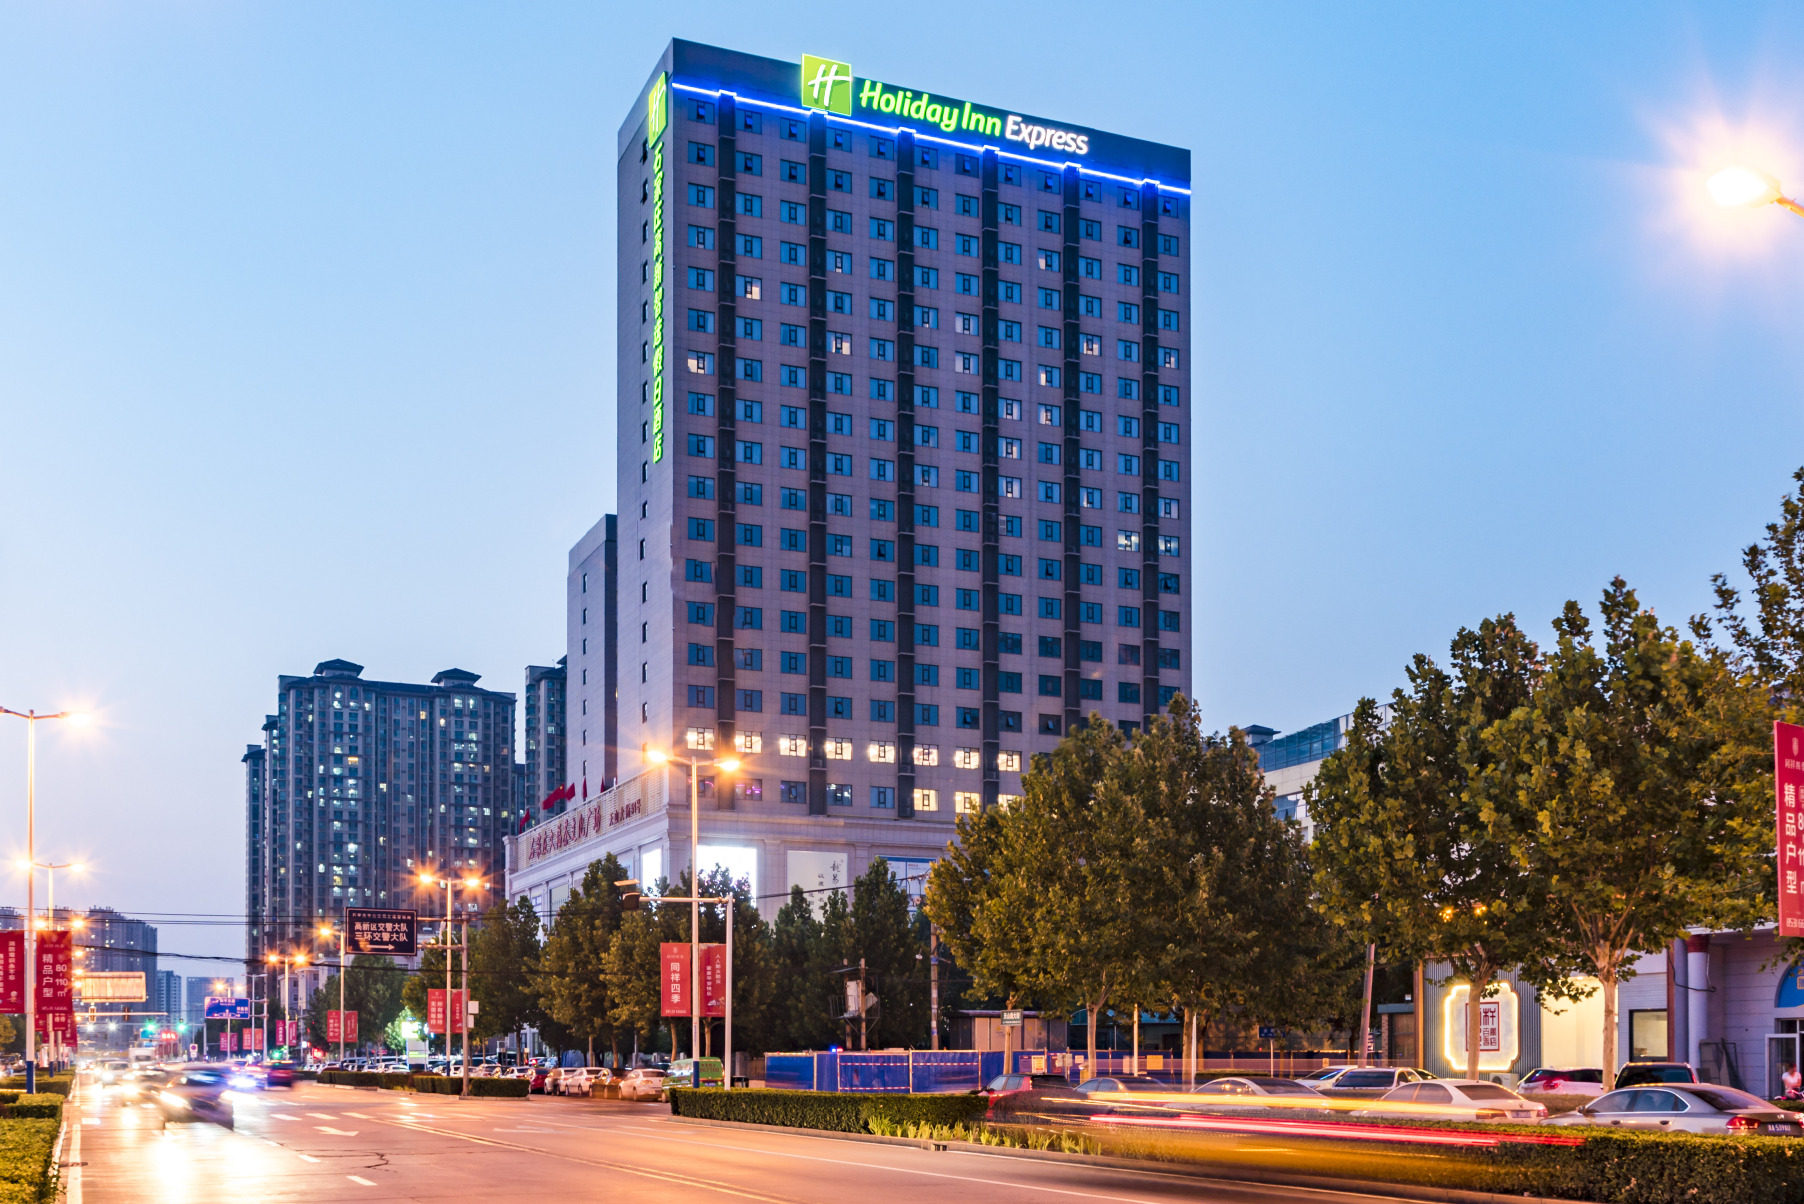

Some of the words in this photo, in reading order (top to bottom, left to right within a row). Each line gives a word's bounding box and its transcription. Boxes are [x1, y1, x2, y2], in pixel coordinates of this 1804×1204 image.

[859, 79, 960, 132] Holiday
[961, 101, 1002, 137] Inn
[1005, 114, 1089, 155] Express
[1784, 782, 1798, 895] 精品户型
[354, 921, 409, 932] 高新区交警大队
[354, 931, 409, 942] 三环交警大队
[42, 953, 54, 998] 精品户型
[670, 962, 681, 1004] 同祥四季
